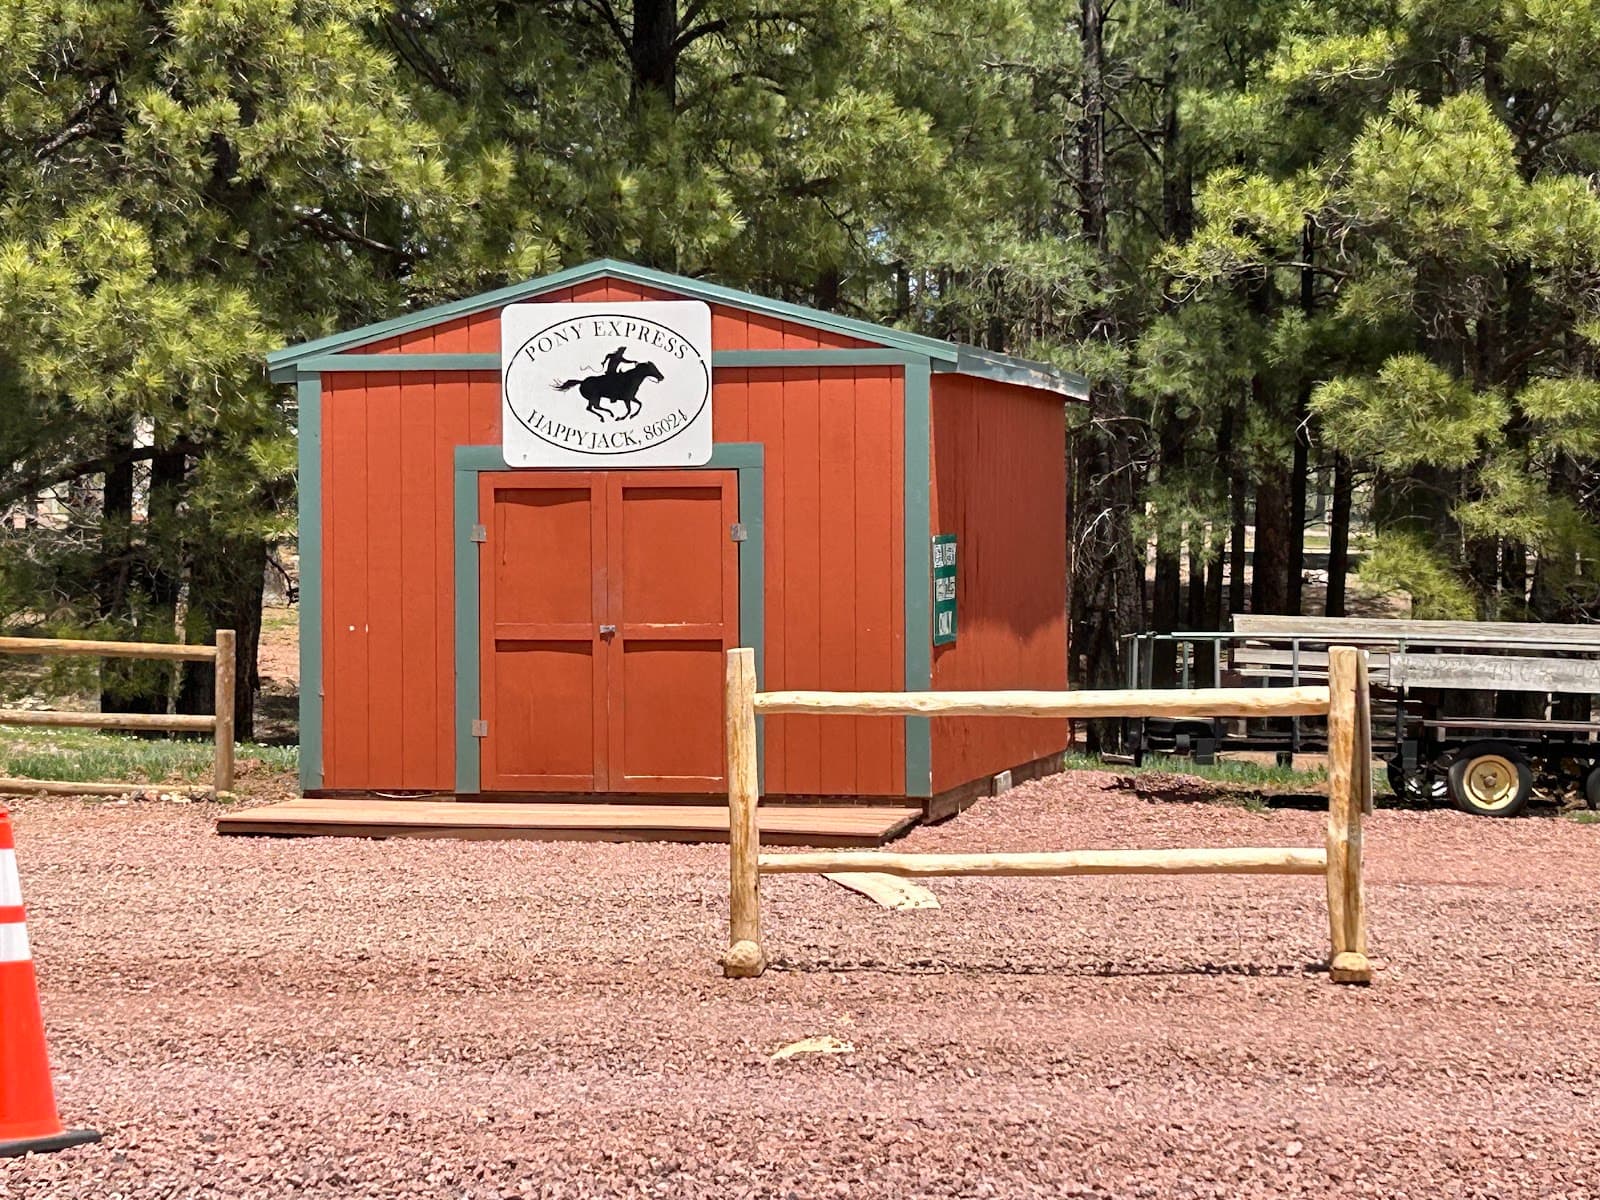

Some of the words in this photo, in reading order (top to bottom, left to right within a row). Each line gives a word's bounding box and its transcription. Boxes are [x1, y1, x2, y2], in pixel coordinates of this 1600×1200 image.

[525, 322, 583, 362] PONY
[593, 320, 689, 360] EXPRESS
[643, 408, 688, 441] 86024
